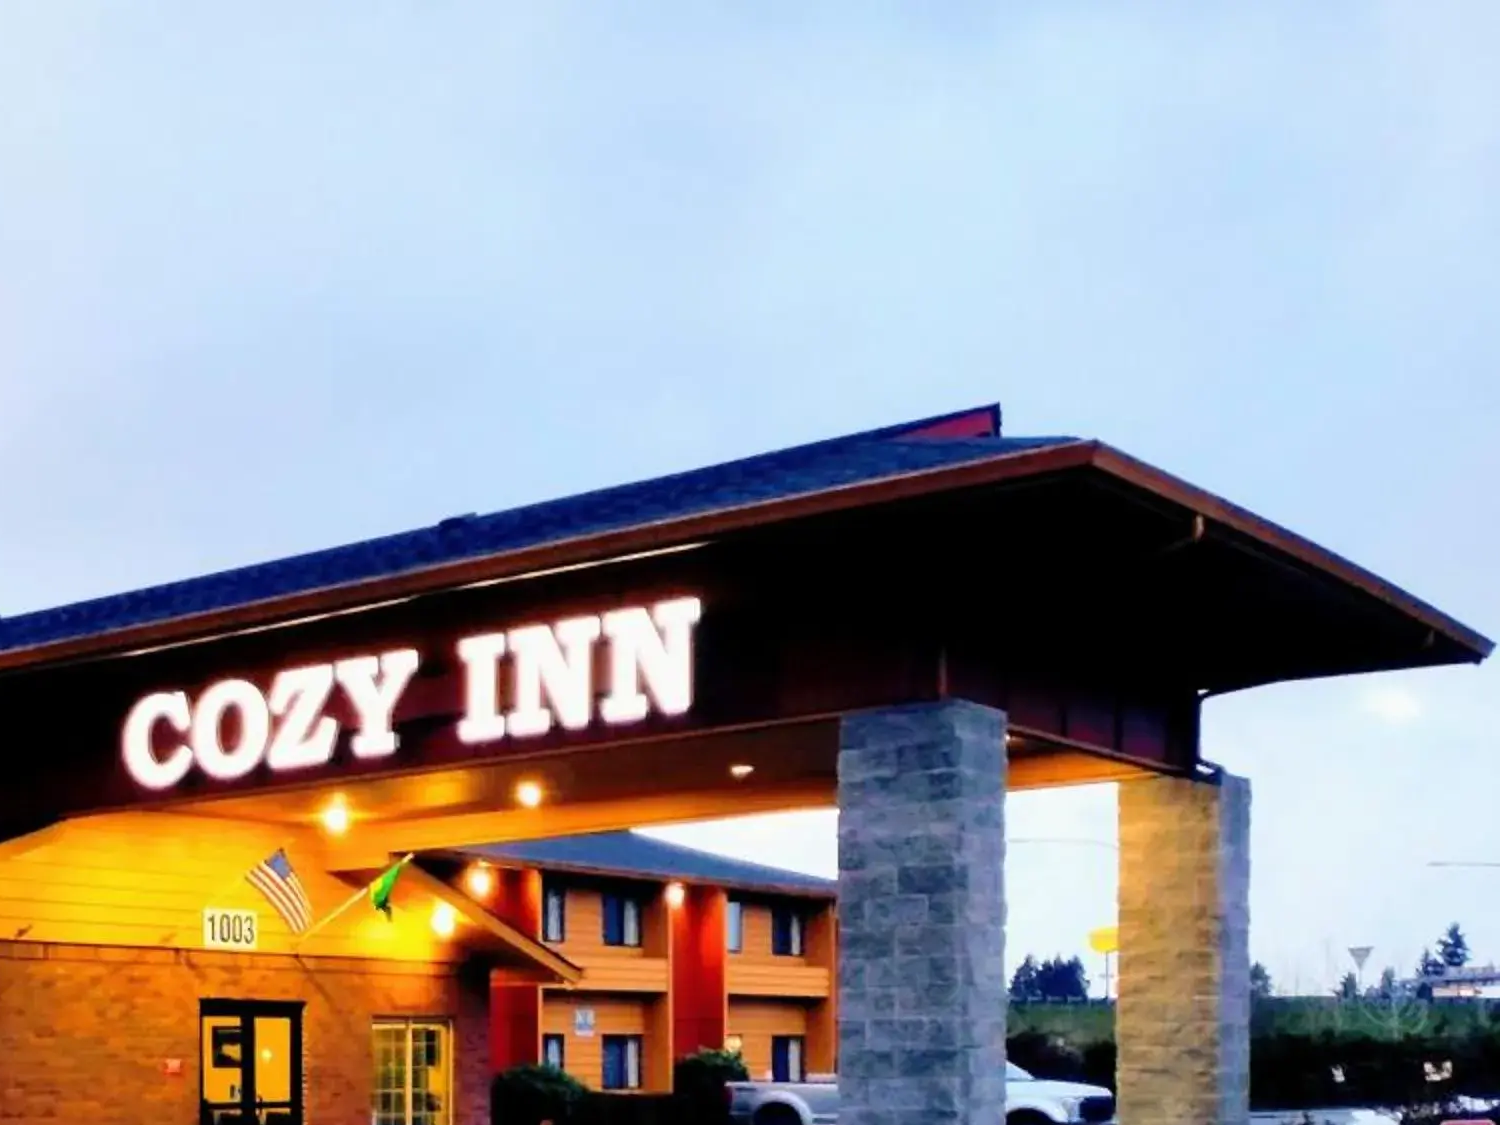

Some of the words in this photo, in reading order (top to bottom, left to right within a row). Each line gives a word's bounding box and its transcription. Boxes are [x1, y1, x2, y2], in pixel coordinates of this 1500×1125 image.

[122, 648, 420, 791] COZY
[455, 596, 702, 745] INN
[207, 913, 255, 945] 1003
